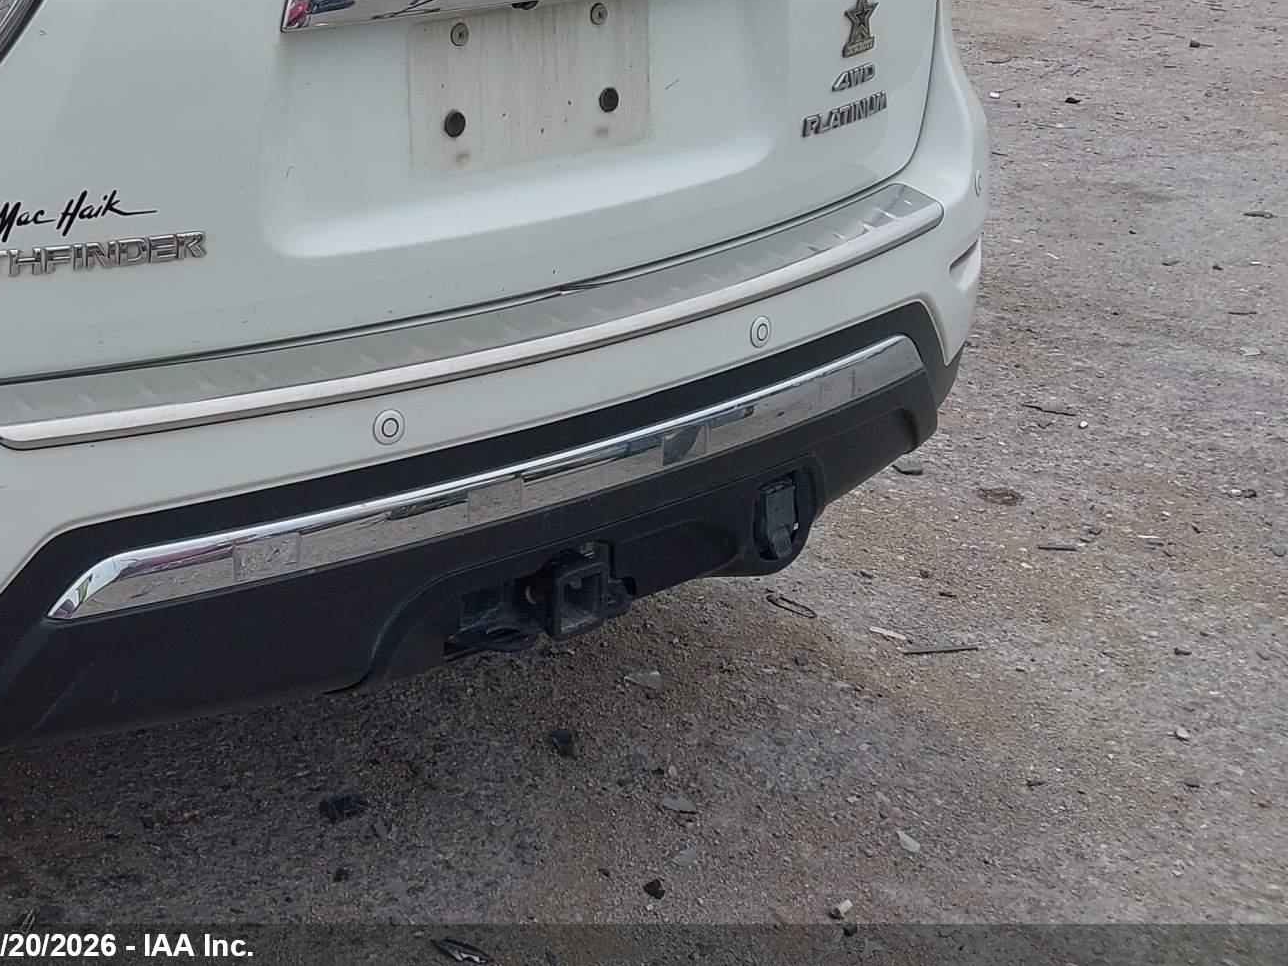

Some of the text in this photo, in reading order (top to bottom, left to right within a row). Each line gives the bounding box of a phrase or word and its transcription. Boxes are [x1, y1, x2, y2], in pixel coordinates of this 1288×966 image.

[832, 62, 876, 92] 4WD
[802, 91, 888, 138] PLATINUM
[56, 190, 157, 236] Haik
